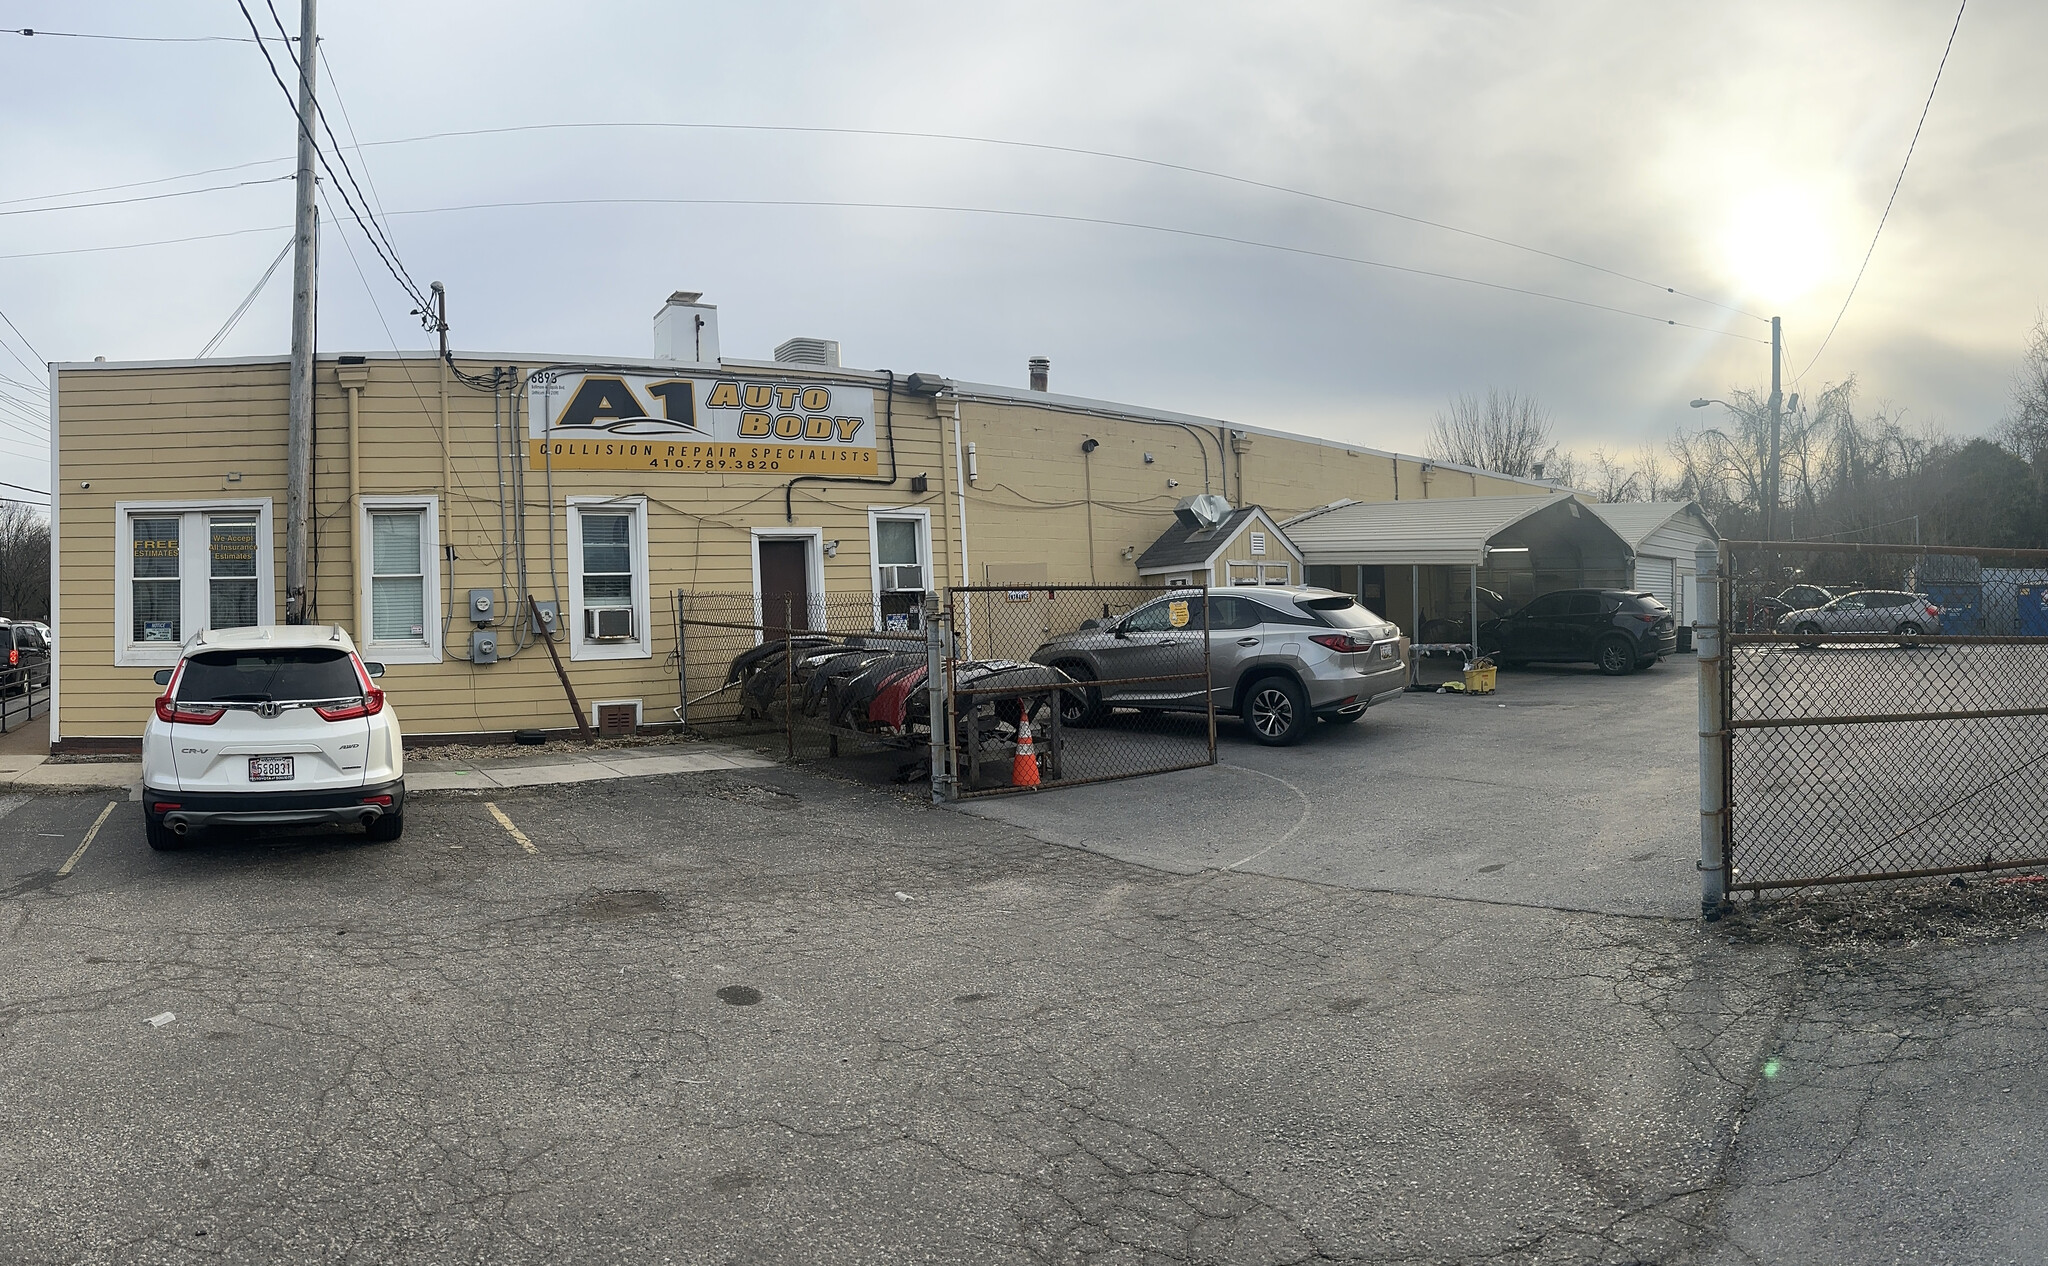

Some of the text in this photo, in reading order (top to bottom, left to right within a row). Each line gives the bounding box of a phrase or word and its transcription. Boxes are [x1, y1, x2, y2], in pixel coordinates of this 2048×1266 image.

[556, 375, 697, 427] A1
[706, 380, 832, 413] AUTO
[737, 410, 865, 443] BODY
[540, 444, 870, 462] COLLISION REPAIR SPECIALISTS
[650, 458, 779, 470] 410.789.3820
[134, 540, 178, 549] FREE
[227, 535, 253, 543] Accept
[134, 549, 179, 557] ESTIMATES
[214, 552, 252, 560] Estimates
